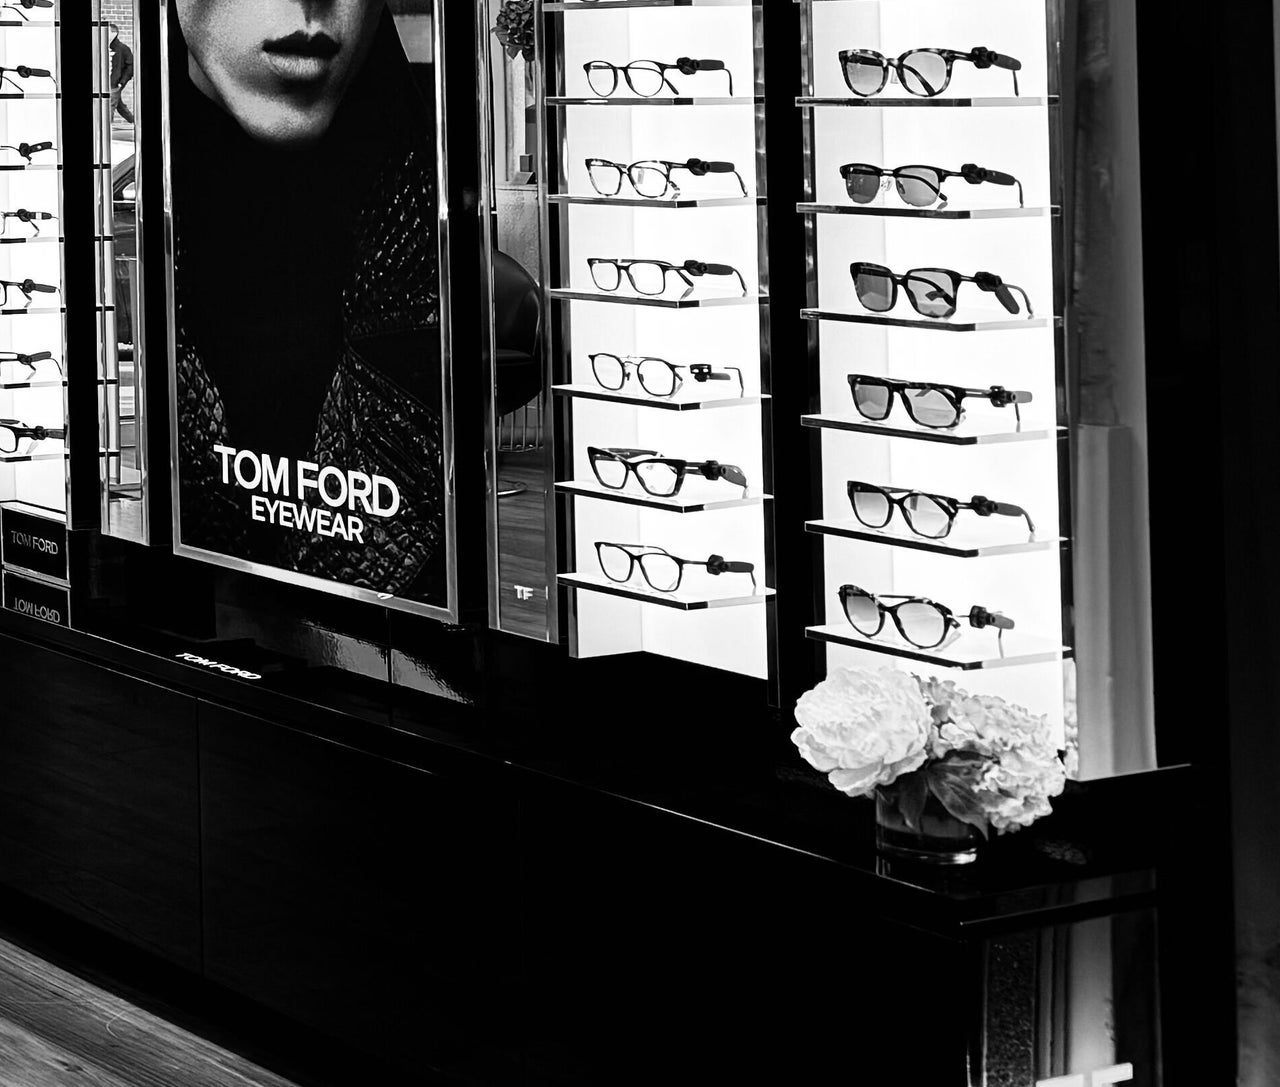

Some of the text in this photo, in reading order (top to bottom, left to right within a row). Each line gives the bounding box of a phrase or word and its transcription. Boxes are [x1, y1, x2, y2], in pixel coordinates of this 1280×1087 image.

[213, 444, 401, 518] TOM FORD
[251, 494, 364, 544] EYEWEAR
[10, 530, 59, 555] TOM FORD
[513, 584, 534, 601] TF
[175, 652, 262, 680] TOM FORD
